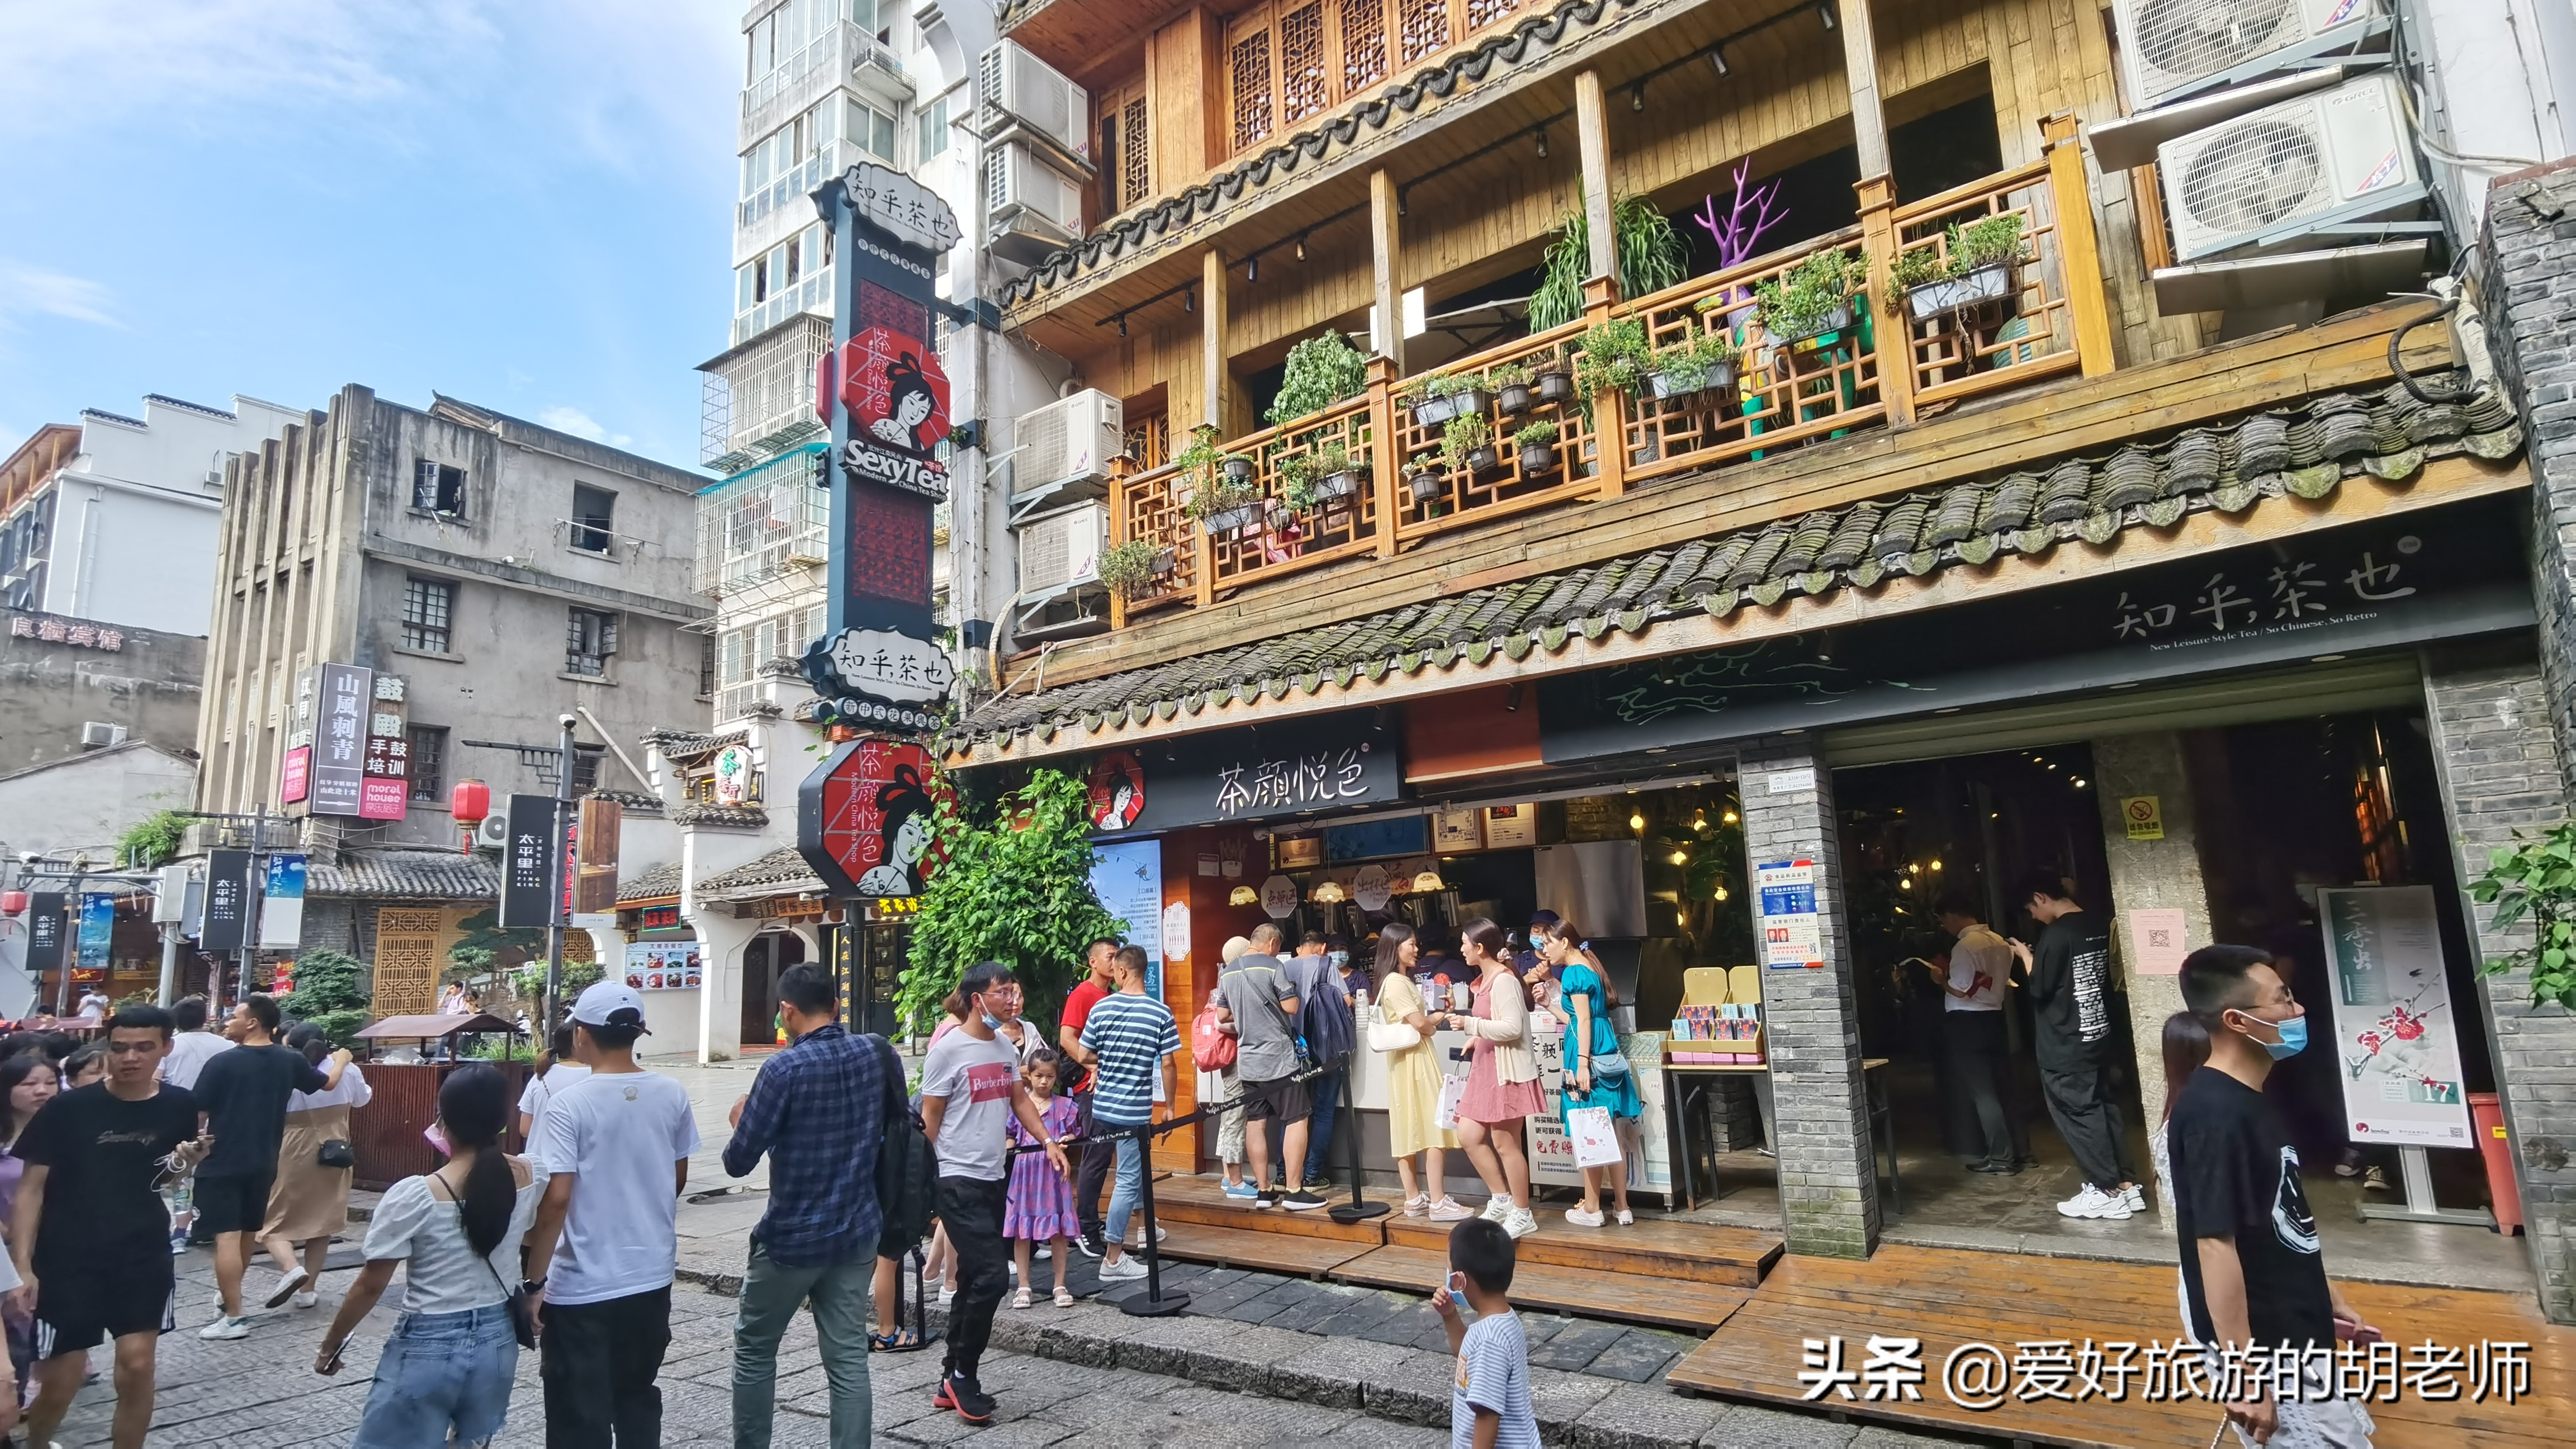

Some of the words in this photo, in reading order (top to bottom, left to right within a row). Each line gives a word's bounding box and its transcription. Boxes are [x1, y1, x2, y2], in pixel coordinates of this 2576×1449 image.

[2344, 86, 2378, 102] GREE
[846, 439, 949, 494] SexyTea
[859, 468, 887, 483] Modern
[898, 480, 917, 492] China
[918, 486, 930, 496] Tea
[930, 489, 947, 501] Shop
[2149, 642, 2171, 652] New
[2174, 636, 2210, 648] Leisure
[2212, 631, 2237, 645] Style
[2238, 628, 2258, 638] Tea
[2266, 625, 2280, 634] So
[2329, 615, 2343, 624] So
[2346, 612, 2378, 622] Retro
[331, 674, 359, 760] 山風刺青
[375, 676, 405, 738] 鼓殿
[370, 739, 408, 757] 手鼓
[367, 757, 405, 775] 培训
[366, 793, 401, 803] house
[367, 784, 401, 795] moral
[517, 834, 535, 868] 太平里
[214, 879, 230, 906] 太平里
[1535, 1126, 1562, 1135] 更可获得
